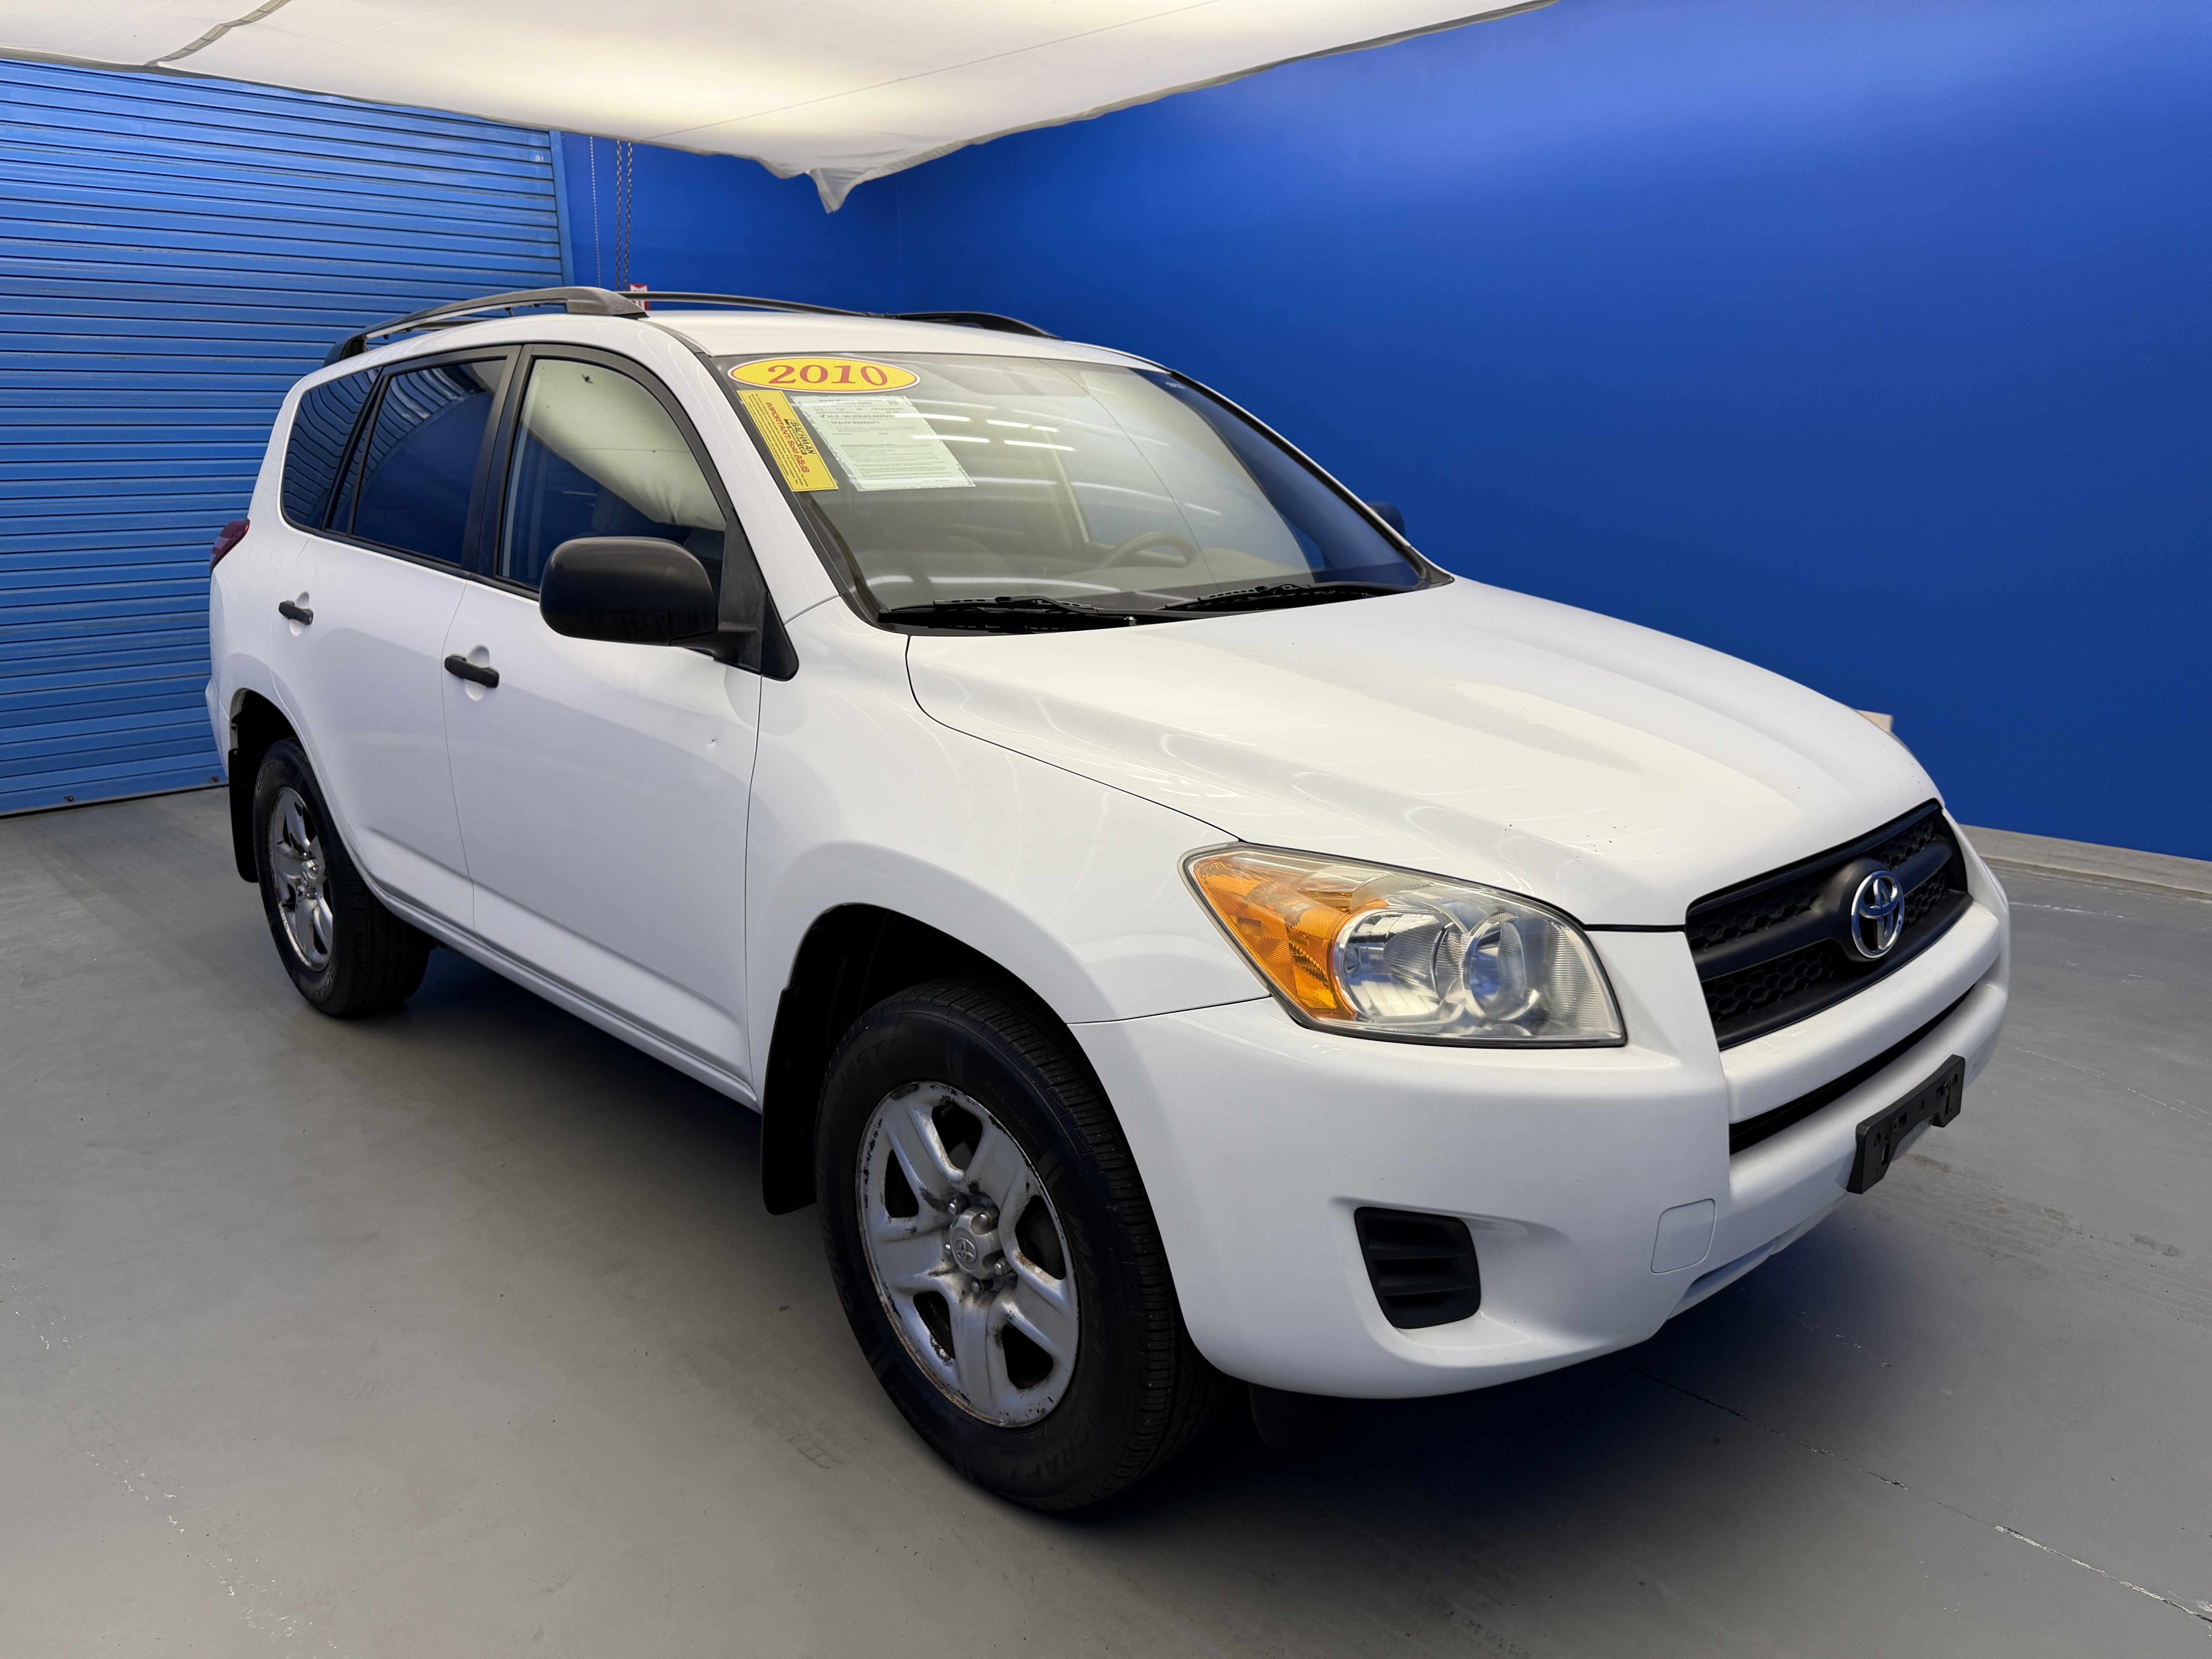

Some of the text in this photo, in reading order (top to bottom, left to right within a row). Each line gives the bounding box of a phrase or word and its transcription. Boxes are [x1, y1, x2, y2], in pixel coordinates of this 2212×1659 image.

[768, 365, 888, 386] 2010
[765, 402, 810, 473] IMPORTANT: Sold AS-IS
[790, 421, 816, 455] BACHMAN
